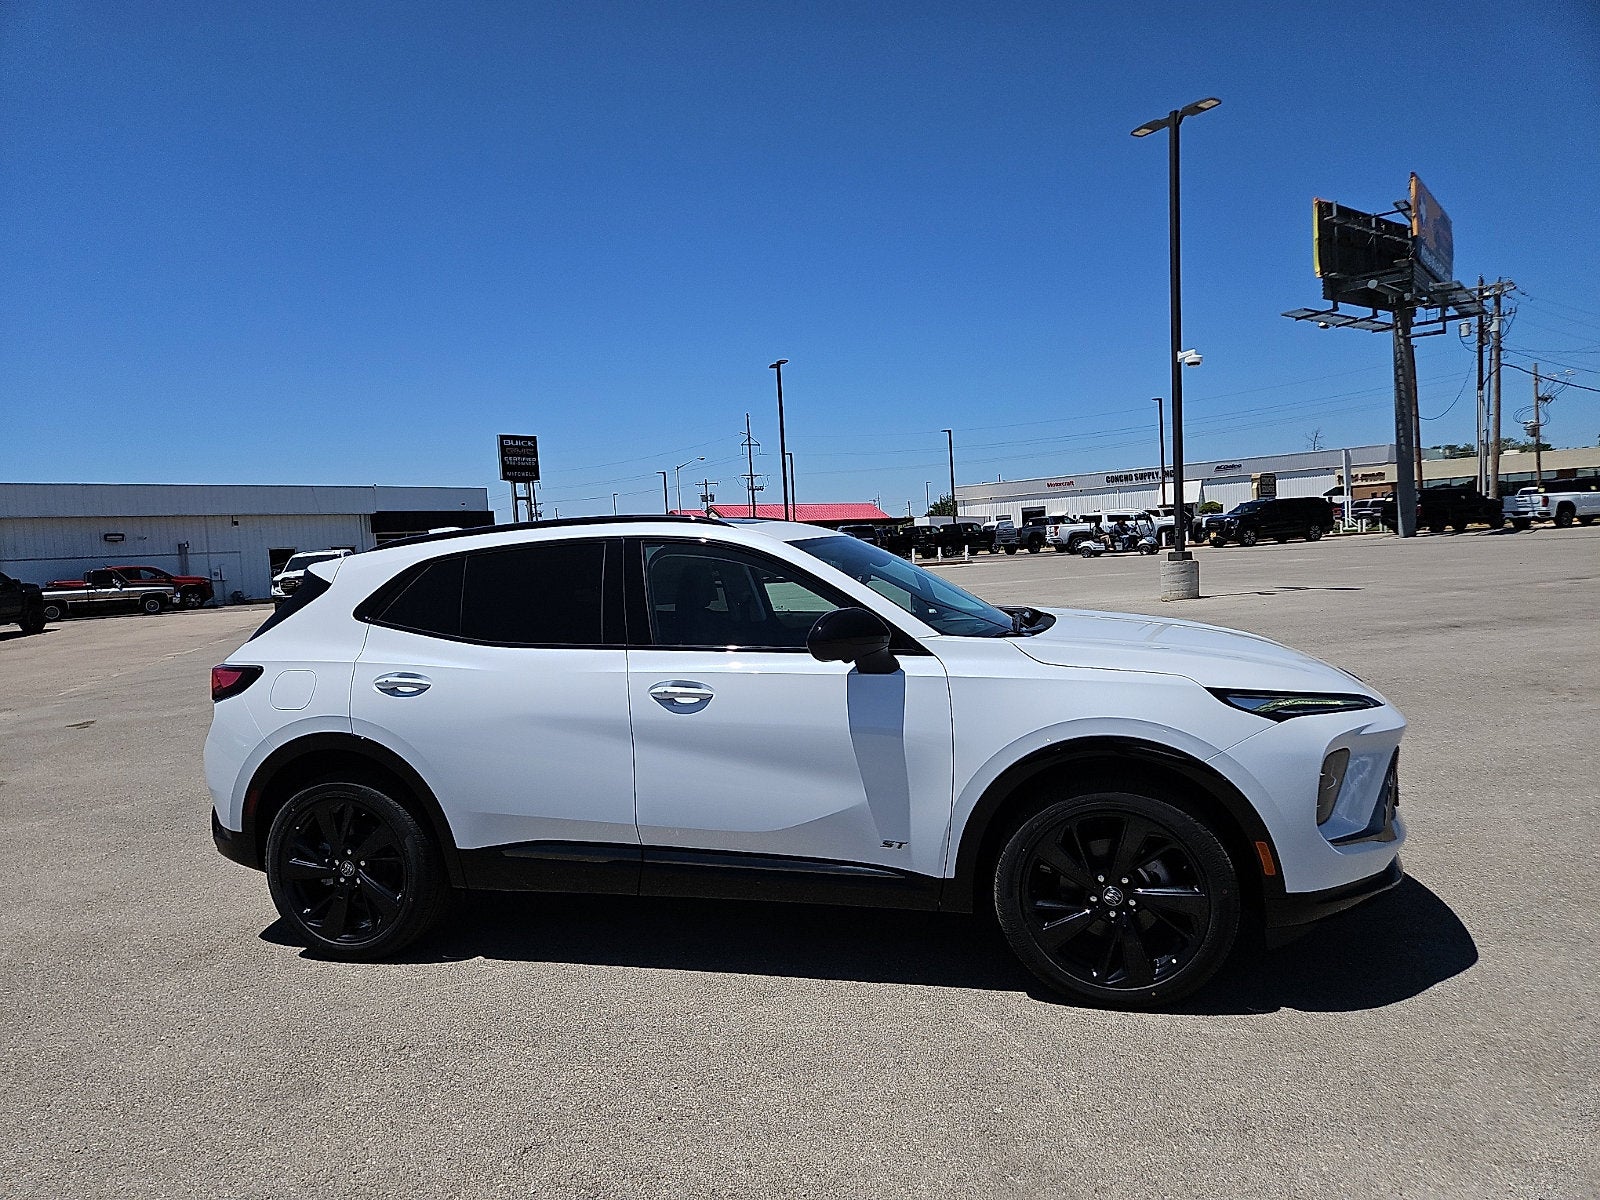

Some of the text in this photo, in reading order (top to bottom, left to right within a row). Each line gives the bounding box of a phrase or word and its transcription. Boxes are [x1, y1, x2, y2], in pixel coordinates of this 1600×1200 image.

[503, 439, 535, 447] BUICK
[1105, 473, 1134, 484] CONCHO
[1046, 480, 1075, 488] Motorcraft
[880, 840, 909, 850] ST
